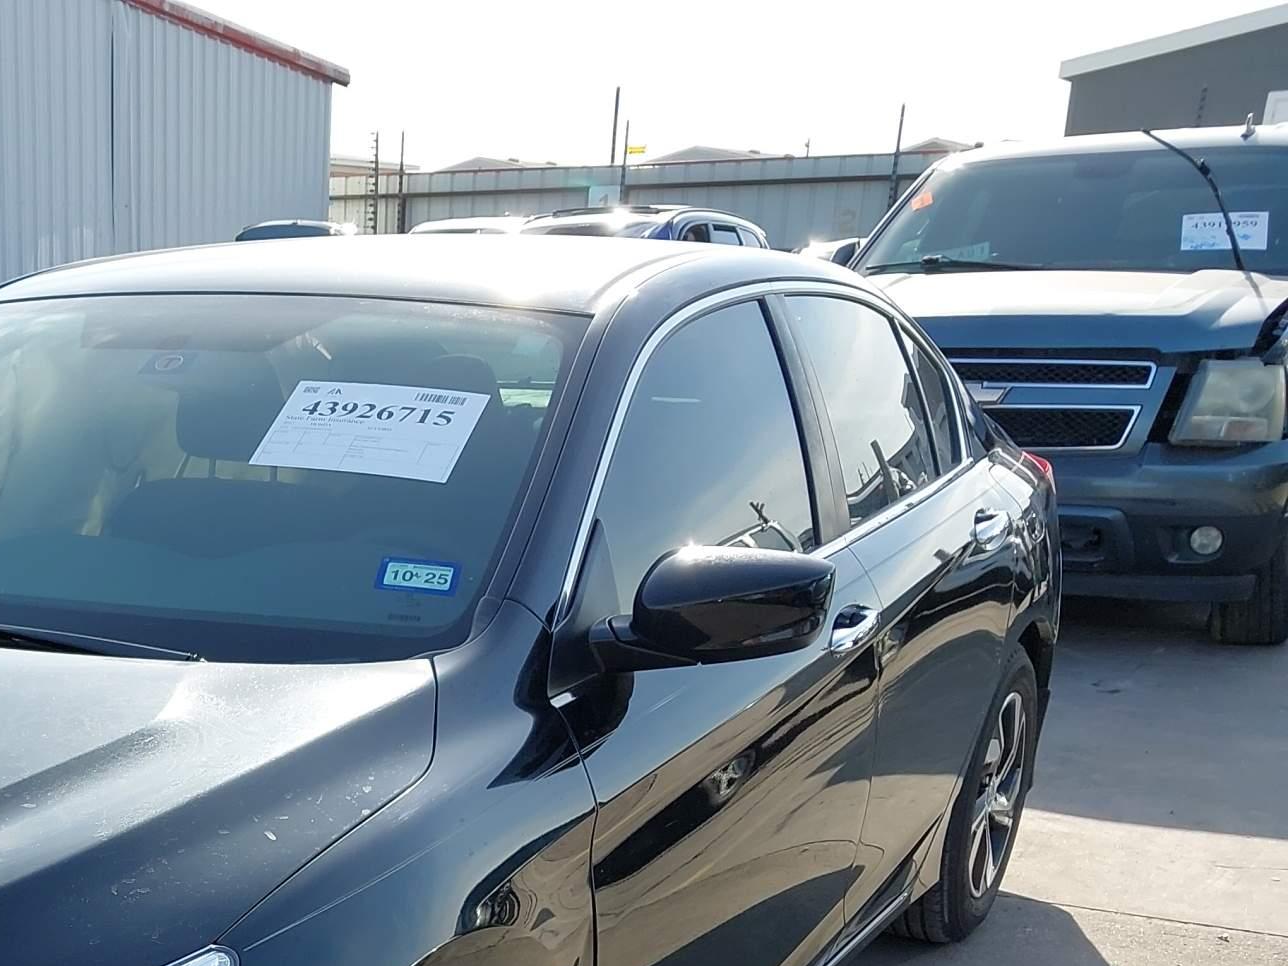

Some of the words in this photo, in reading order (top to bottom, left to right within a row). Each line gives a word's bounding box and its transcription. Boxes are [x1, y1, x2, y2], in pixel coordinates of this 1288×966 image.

[1192, 220, 1257, 229] 4391959
[302, 400, 456, 426] 43926715
[391, 569, 414, 582] 10
[423, 572, 450, 585] 25
